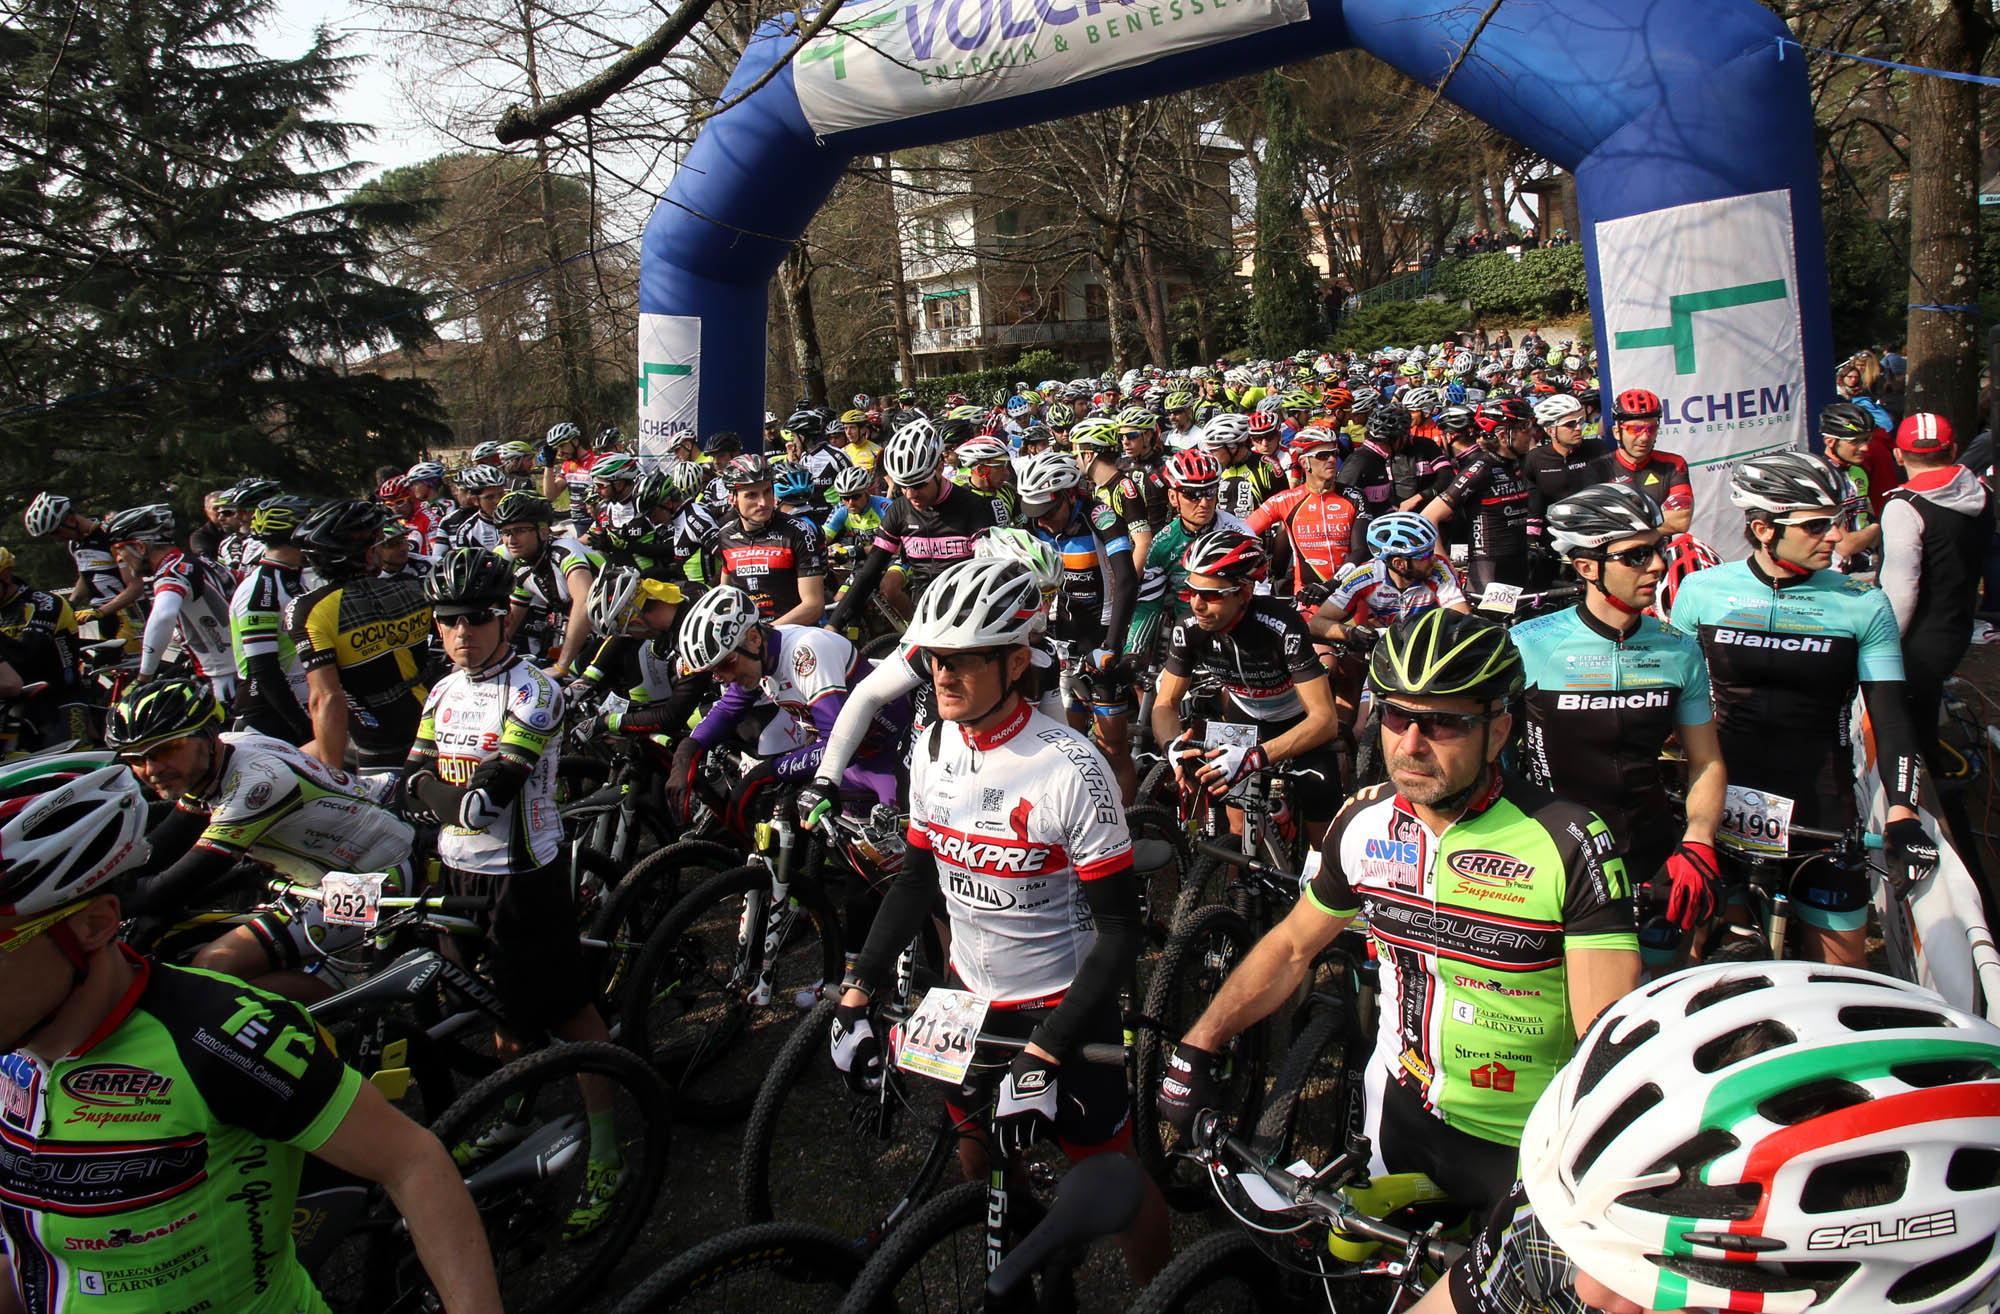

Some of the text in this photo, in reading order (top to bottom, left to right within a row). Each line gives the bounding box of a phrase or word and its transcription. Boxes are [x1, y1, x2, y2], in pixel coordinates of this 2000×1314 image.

[1054, 34, 1069, 52] &
[1706, 414, 1792, 432] BENESSERE
[737, 565, 768, 575] SOUDAL
[1714, 629, 1833, 653] Bianchi
[1557, 691, 1670, 710] Bianchi
[1037, 728, 1119, 825] PARKPRE
[1721, 808, 1781, 839] 2190
[1365, 838, 1418, 865] AVIS
[1457, 855, 1536, 880] ERREPI
[949, 876, 1003, 906] ITALIA
[1452, 881, 1526, 904] Suspension
[332, 892, 366, 918] 252
[1474, 1018, 1544, 1035] CARNEVALI
[1476, 1007, 1543, 1024] FALEGNAMERIA
[910, 1015, 968, 1054] 2134
[193, 1026, 295, 1098] Tecnoricambi Casentino
[1455, 1044, 1533, 1063] Street Saloon
[72, 1072, 174, 1095] ERREPI
[64, 1105, 162, 1128] Suspension
[1807, 1209, 1958, 1250] SALICE
[106, 1245, 209, 1279] FALEGNAMERIA
[106, 1253, 211, 1294] CARNEVALI
